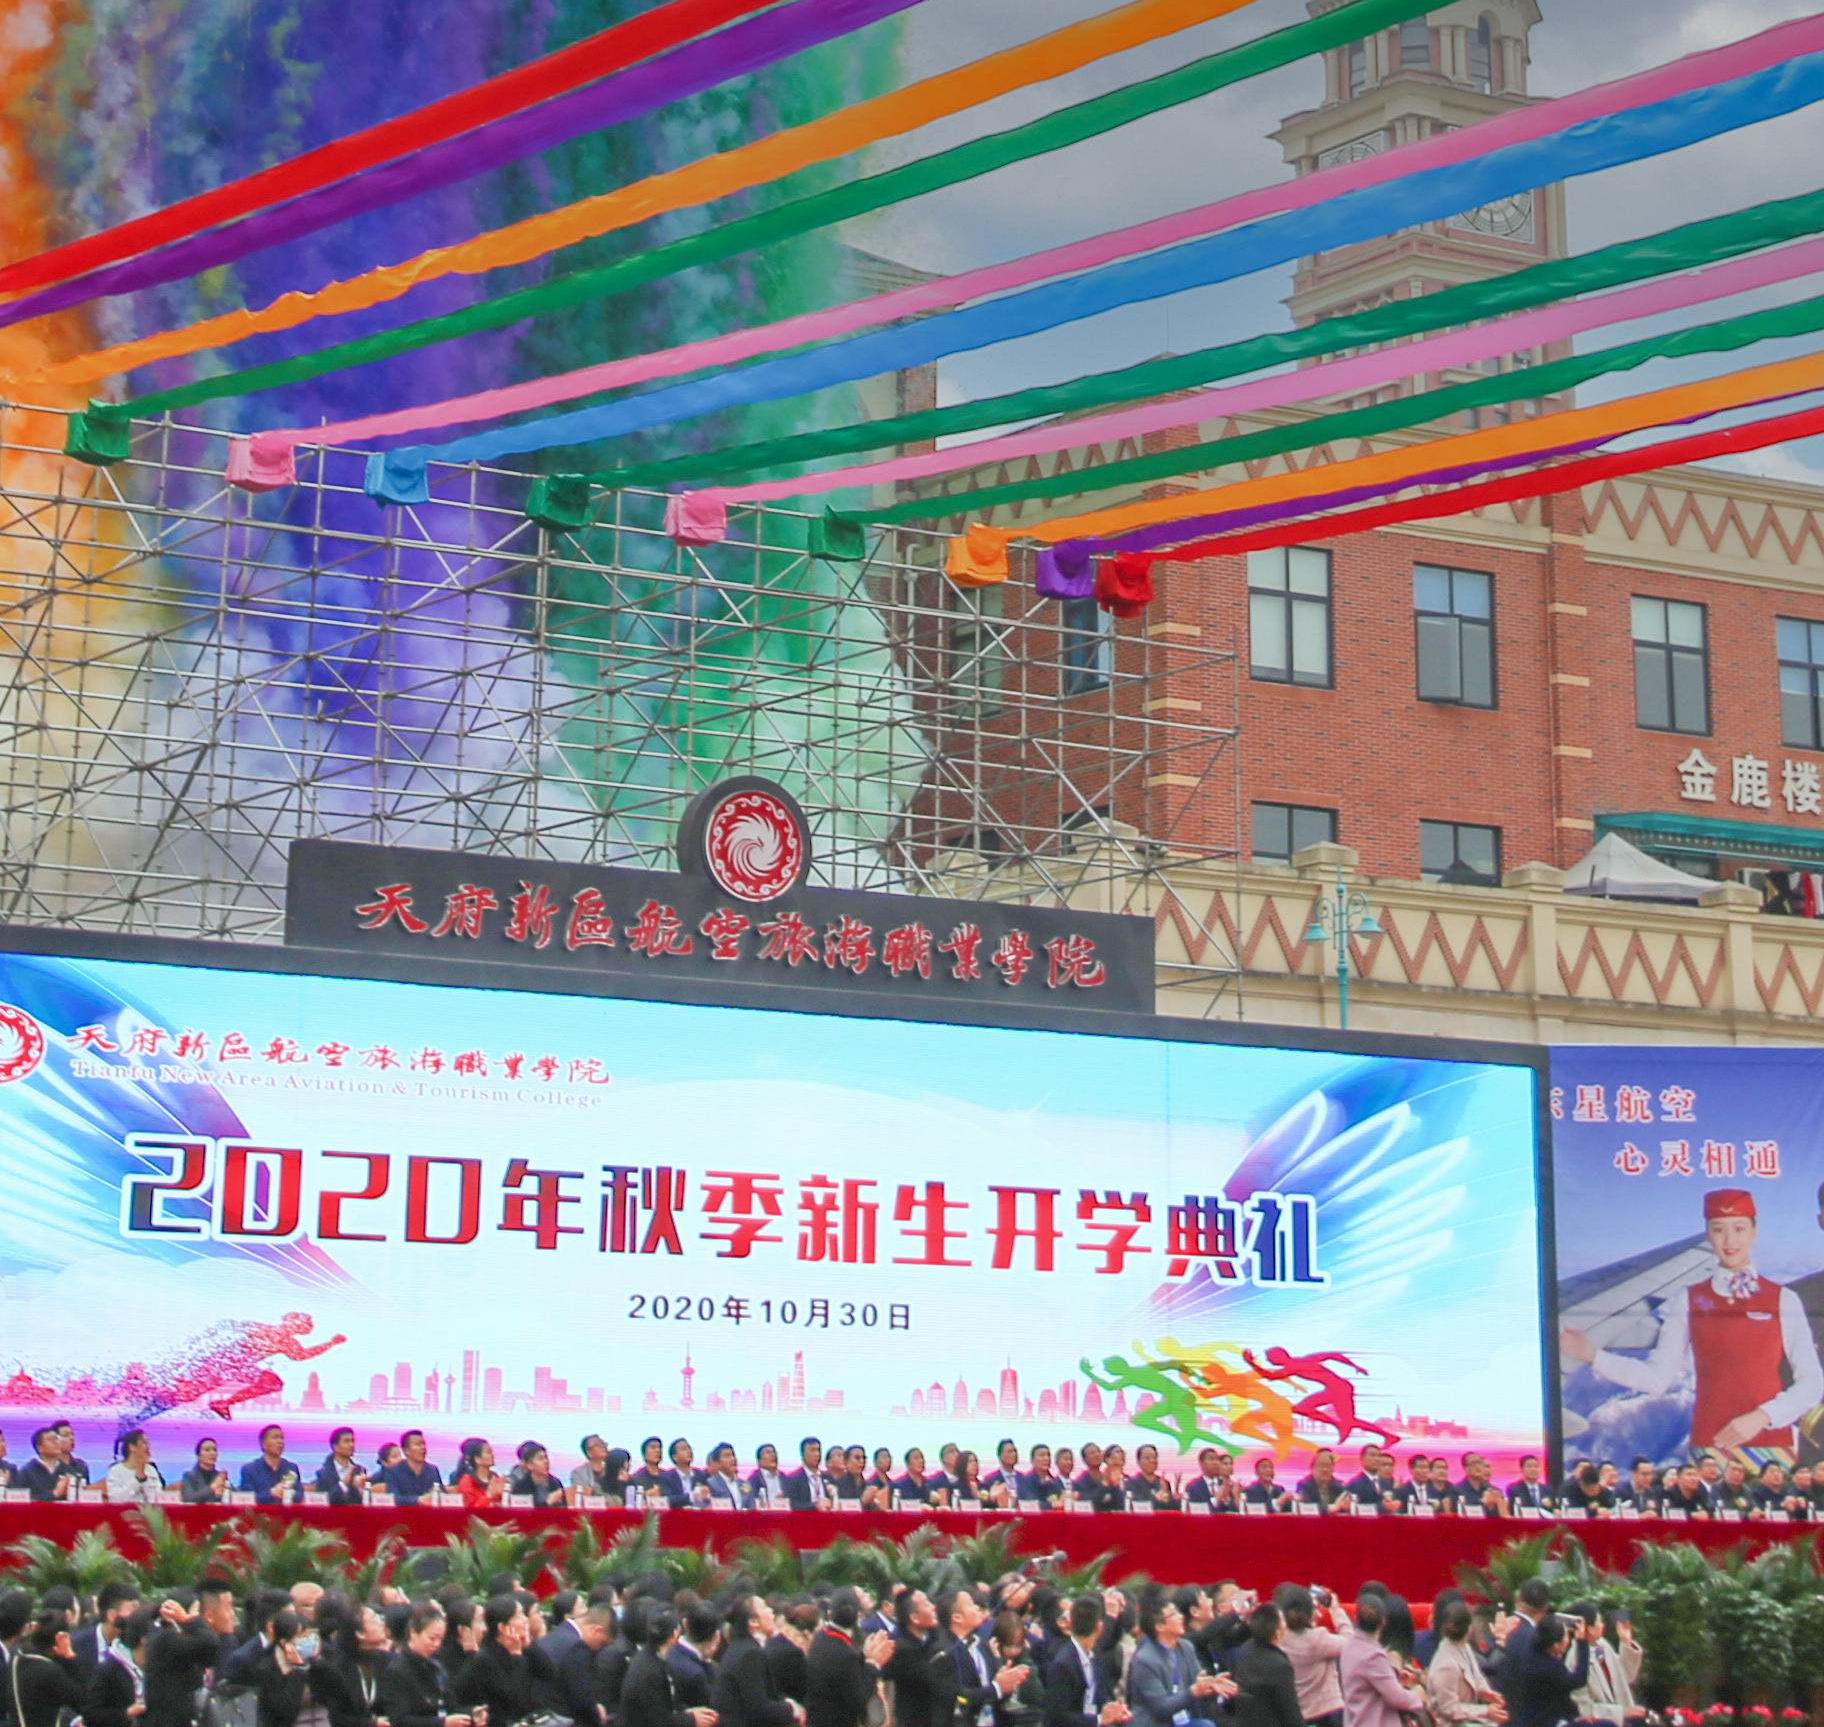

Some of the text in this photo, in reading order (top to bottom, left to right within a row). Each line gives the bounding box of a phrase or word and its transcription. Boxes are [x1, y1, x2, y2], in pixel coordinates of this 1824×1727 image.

[1677, 748, 1822, 815] 金鹿楼
[74, 1060, 602, 1109] Tianfu New Area Aviation & Tourism College
[1613, 1139, 1781, 1178] 心灵相通
[126, 1135, 1327, 1286] 2020年秋季新生开学典礼
[627, 1293, 911, 1331] 2020年10月30日
